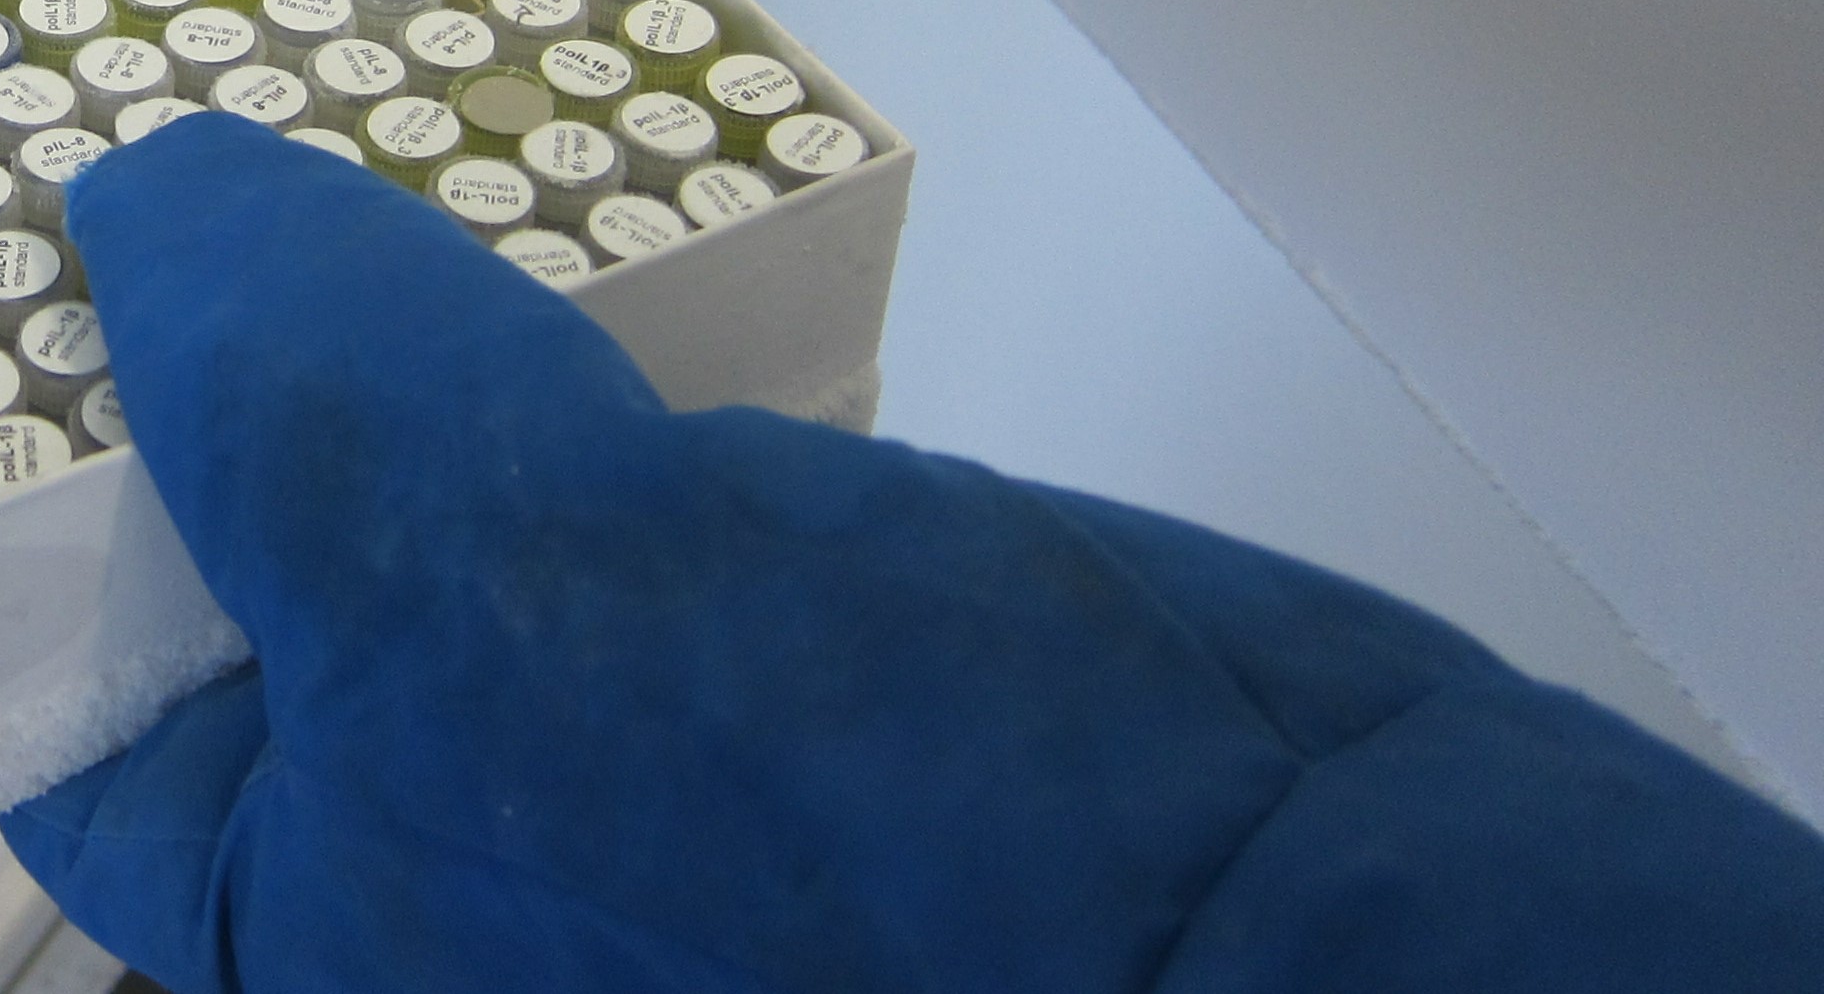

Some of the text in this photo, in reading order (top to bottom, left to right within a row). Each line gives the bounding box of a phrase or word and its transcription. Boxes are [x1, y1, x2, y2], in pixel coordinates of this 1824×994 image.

[182, 20, 242, 38] standard
[421, 19, 466, 49] standard
[667, 7, 687, 46] standard
[187, 37, 231, 47] pIL-8
[442, 29, 476, 55] pIL-8
[98, 42, 130, 79] standard
[120, 50, 145, 79] pIL-8
[340, 46, 373, 86] standard
[357, 48, 387, 76] pIL-8
[552, 58, 610, 87] standard
[231, 73, 280, 106] standard
[719, 68, 775, 91] standard
[0, 87, 39, 112] pIL-8
[251, 84, 288, 111] pIL-8
[385, 106, 424, 142] standard
[647, 115, 700, 137] standard
[41, 146, 102, 168] standard
[43, 136, 86, 156] pIL-8
[453, 177, 517, 192] standard
[613, 206, 672, 240] standard
[14, 242, 29, 286] standard
[21, 426, 37, 478] standard
